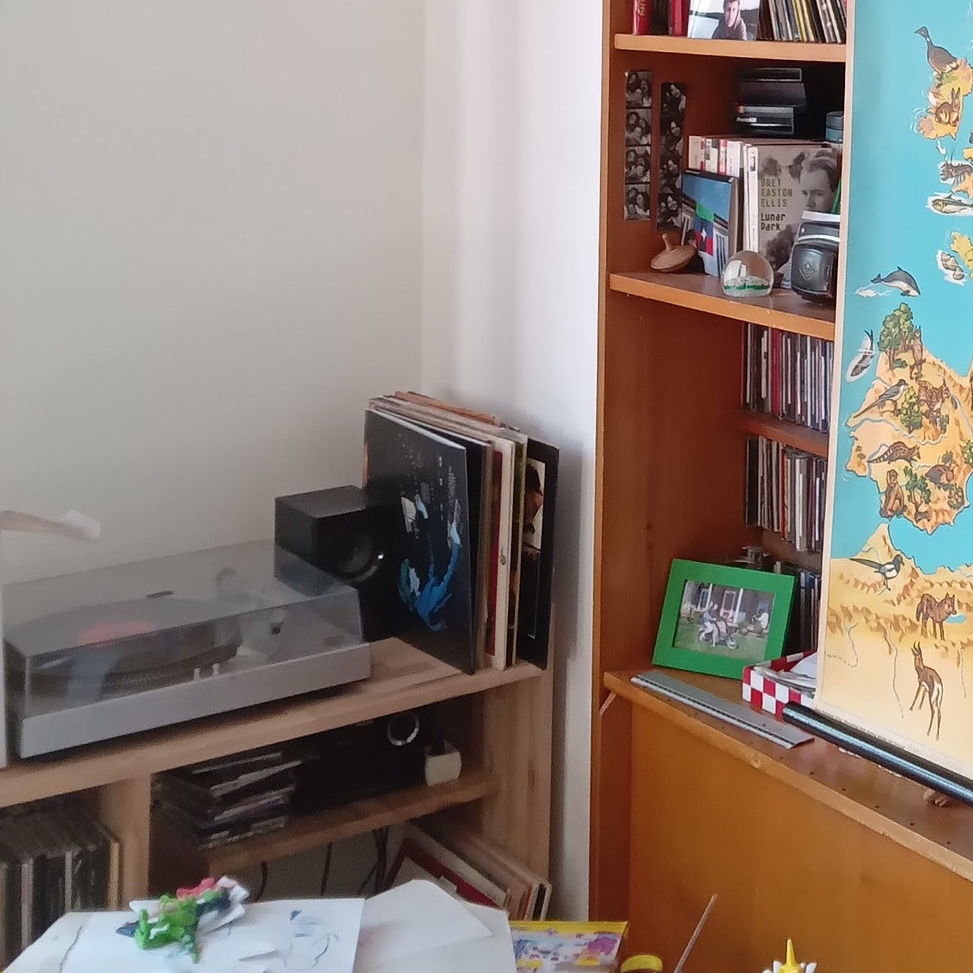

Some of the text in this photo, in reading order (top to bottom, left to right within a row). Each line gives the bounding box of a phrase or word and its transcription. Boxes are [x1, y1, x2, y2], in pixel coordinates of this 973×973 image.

[760, 178, 781, 187] BRET
[760, 188, 793, 197] EASTON
[760, 198, 788, 208] ELLIS
[760, 212, 786, 222] Lunar
[760, 222, 781, 231] Park
